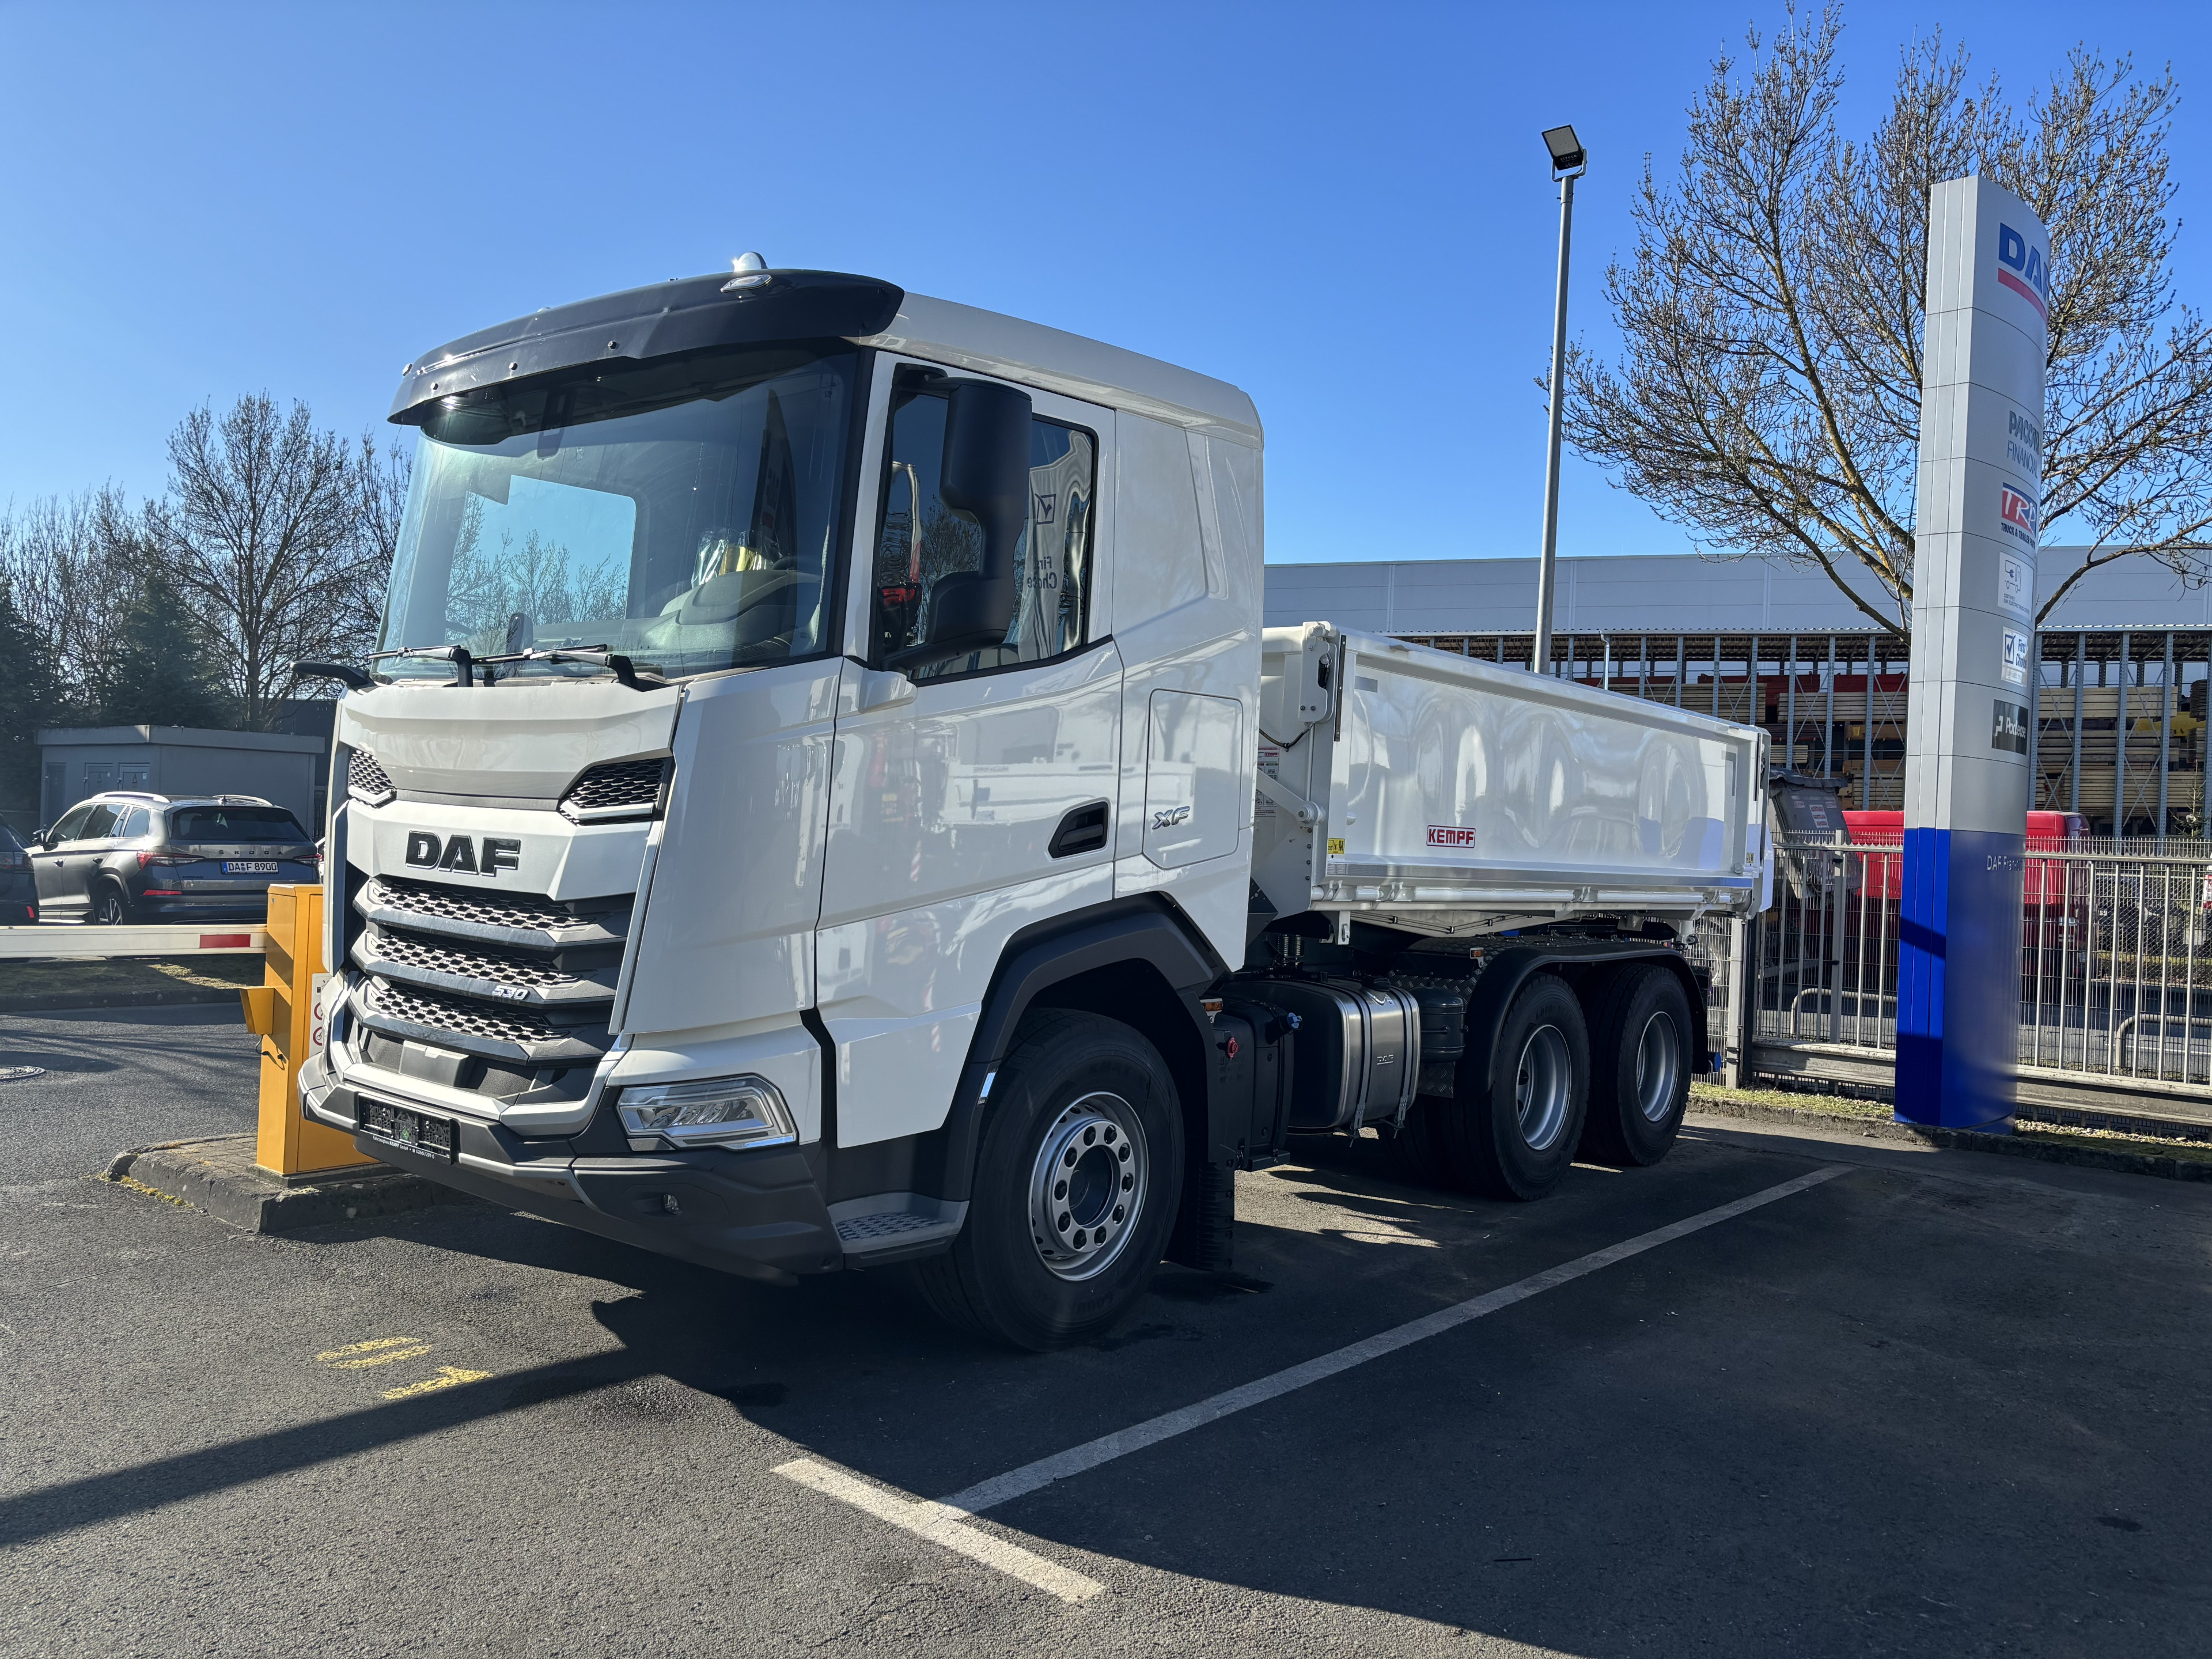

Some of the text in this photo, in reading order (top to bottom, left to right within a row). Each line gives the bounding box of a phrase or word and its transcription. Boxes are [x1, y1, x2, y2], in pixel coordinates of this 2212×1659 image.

[2003, 487, 2036, 535] TRP
[2001, 522, 2014, 536] TRUCK
[1152, 806, 1190, 830] XF
[1429, 828, 1474, 844] KEMPF
[406, 831, 521, 877] DAF
[228, 863, 241, 871] DA
[1987, 855, 2002, 870] DAF
[492, 985, 530, 999] 530
